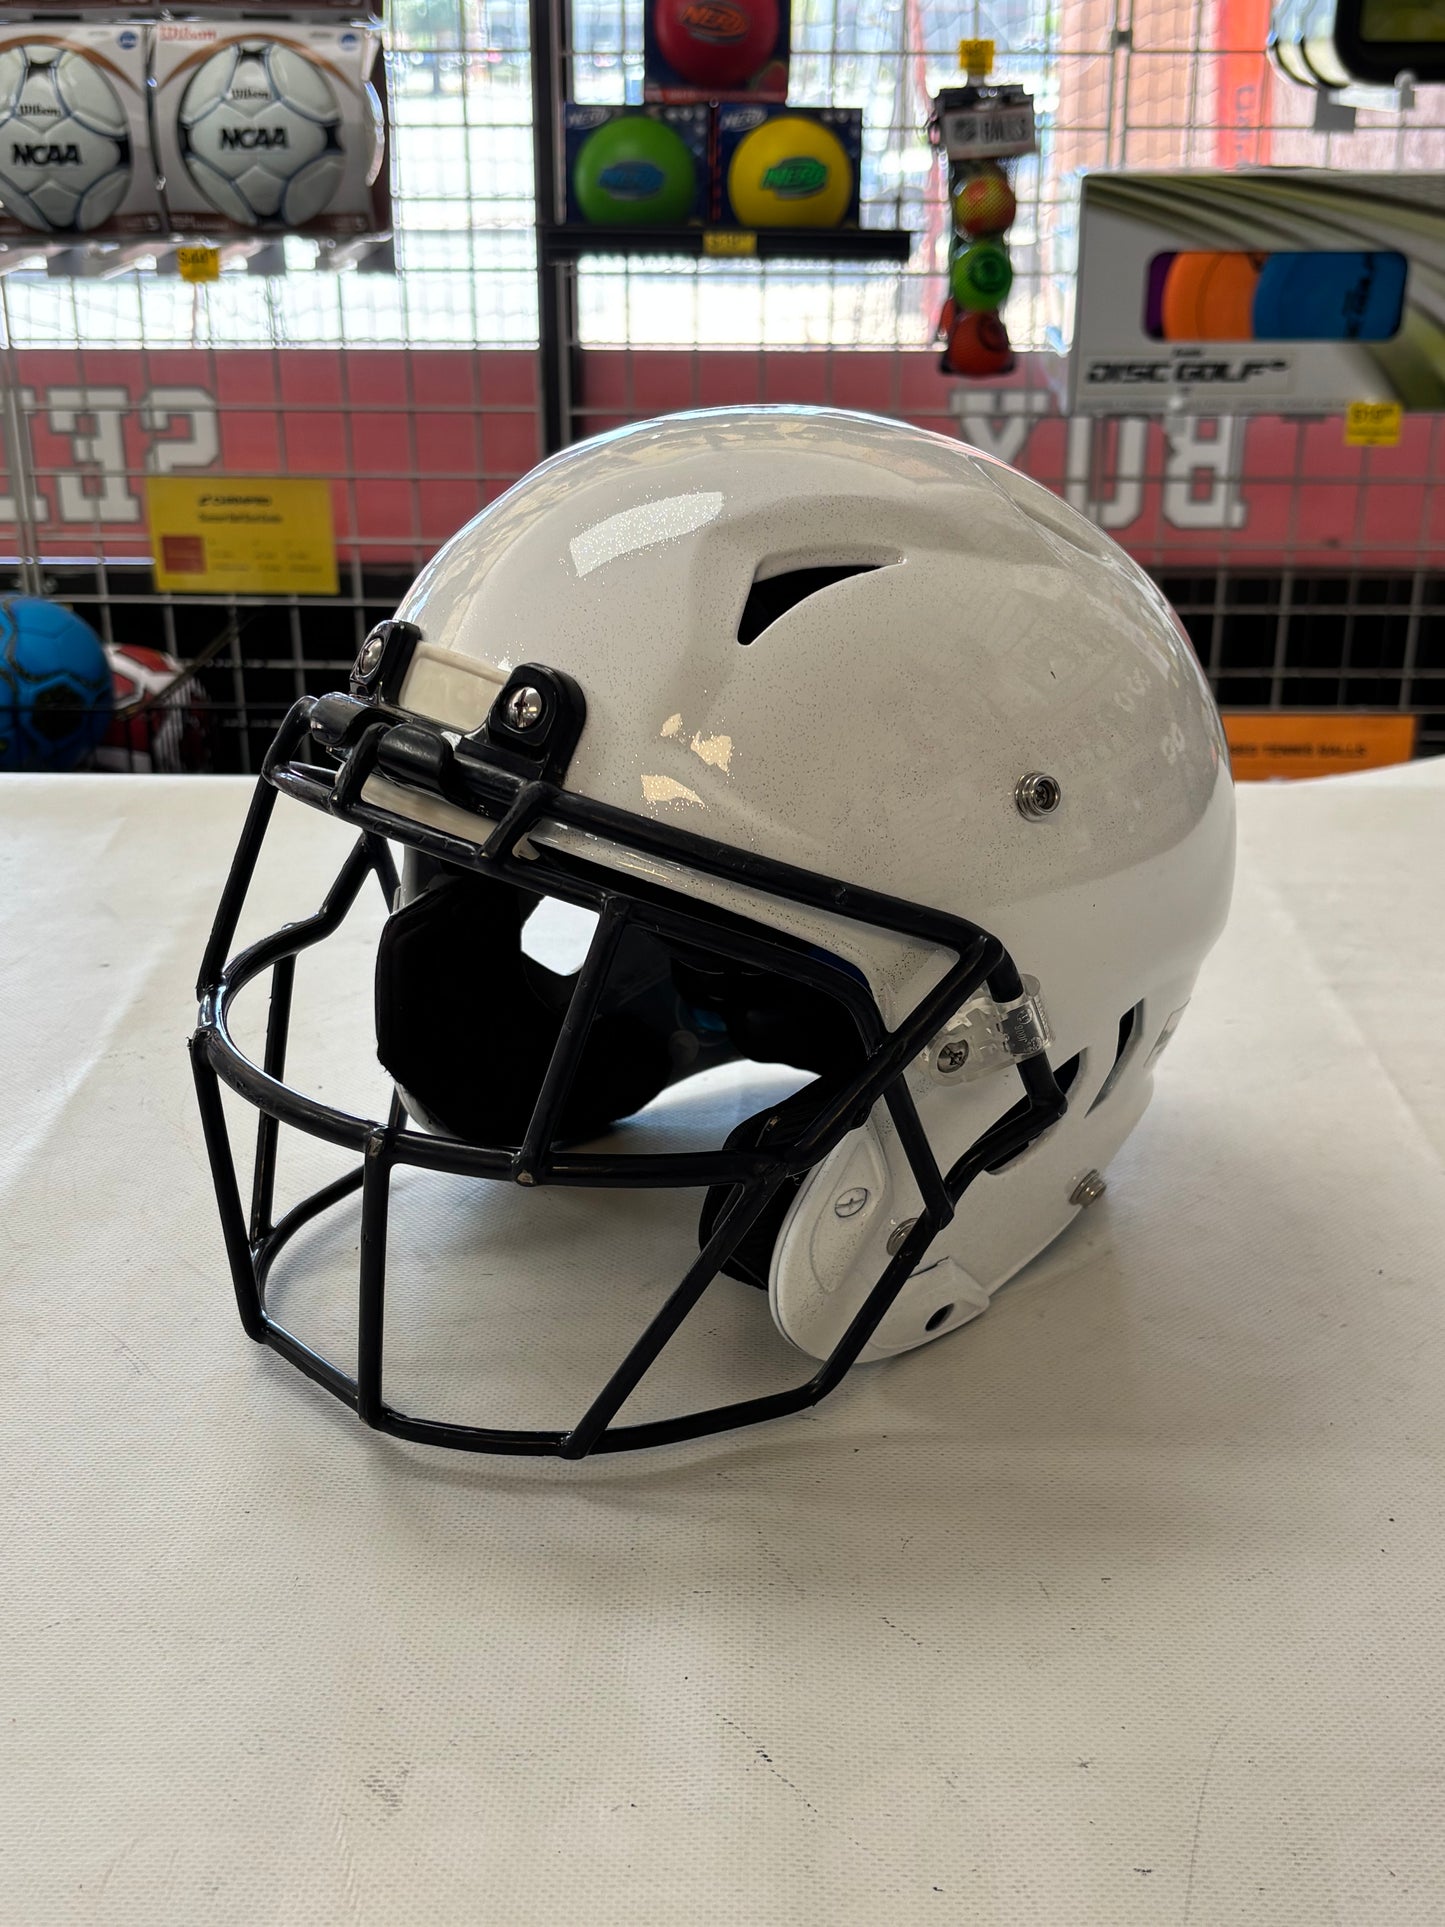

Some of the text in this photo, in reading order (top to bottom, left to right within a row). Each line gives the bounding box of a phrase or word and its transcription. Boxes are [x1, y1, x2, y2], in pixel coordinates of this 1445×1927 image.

[231, 88, 270, 100] Wilson
[19, 104, 62, 116] Wilson
[219, 127, 288, 149] NCAA
[12, 144, 82, 165] NCAA
[1087, 361, 1266, 383] DISC GOLF
